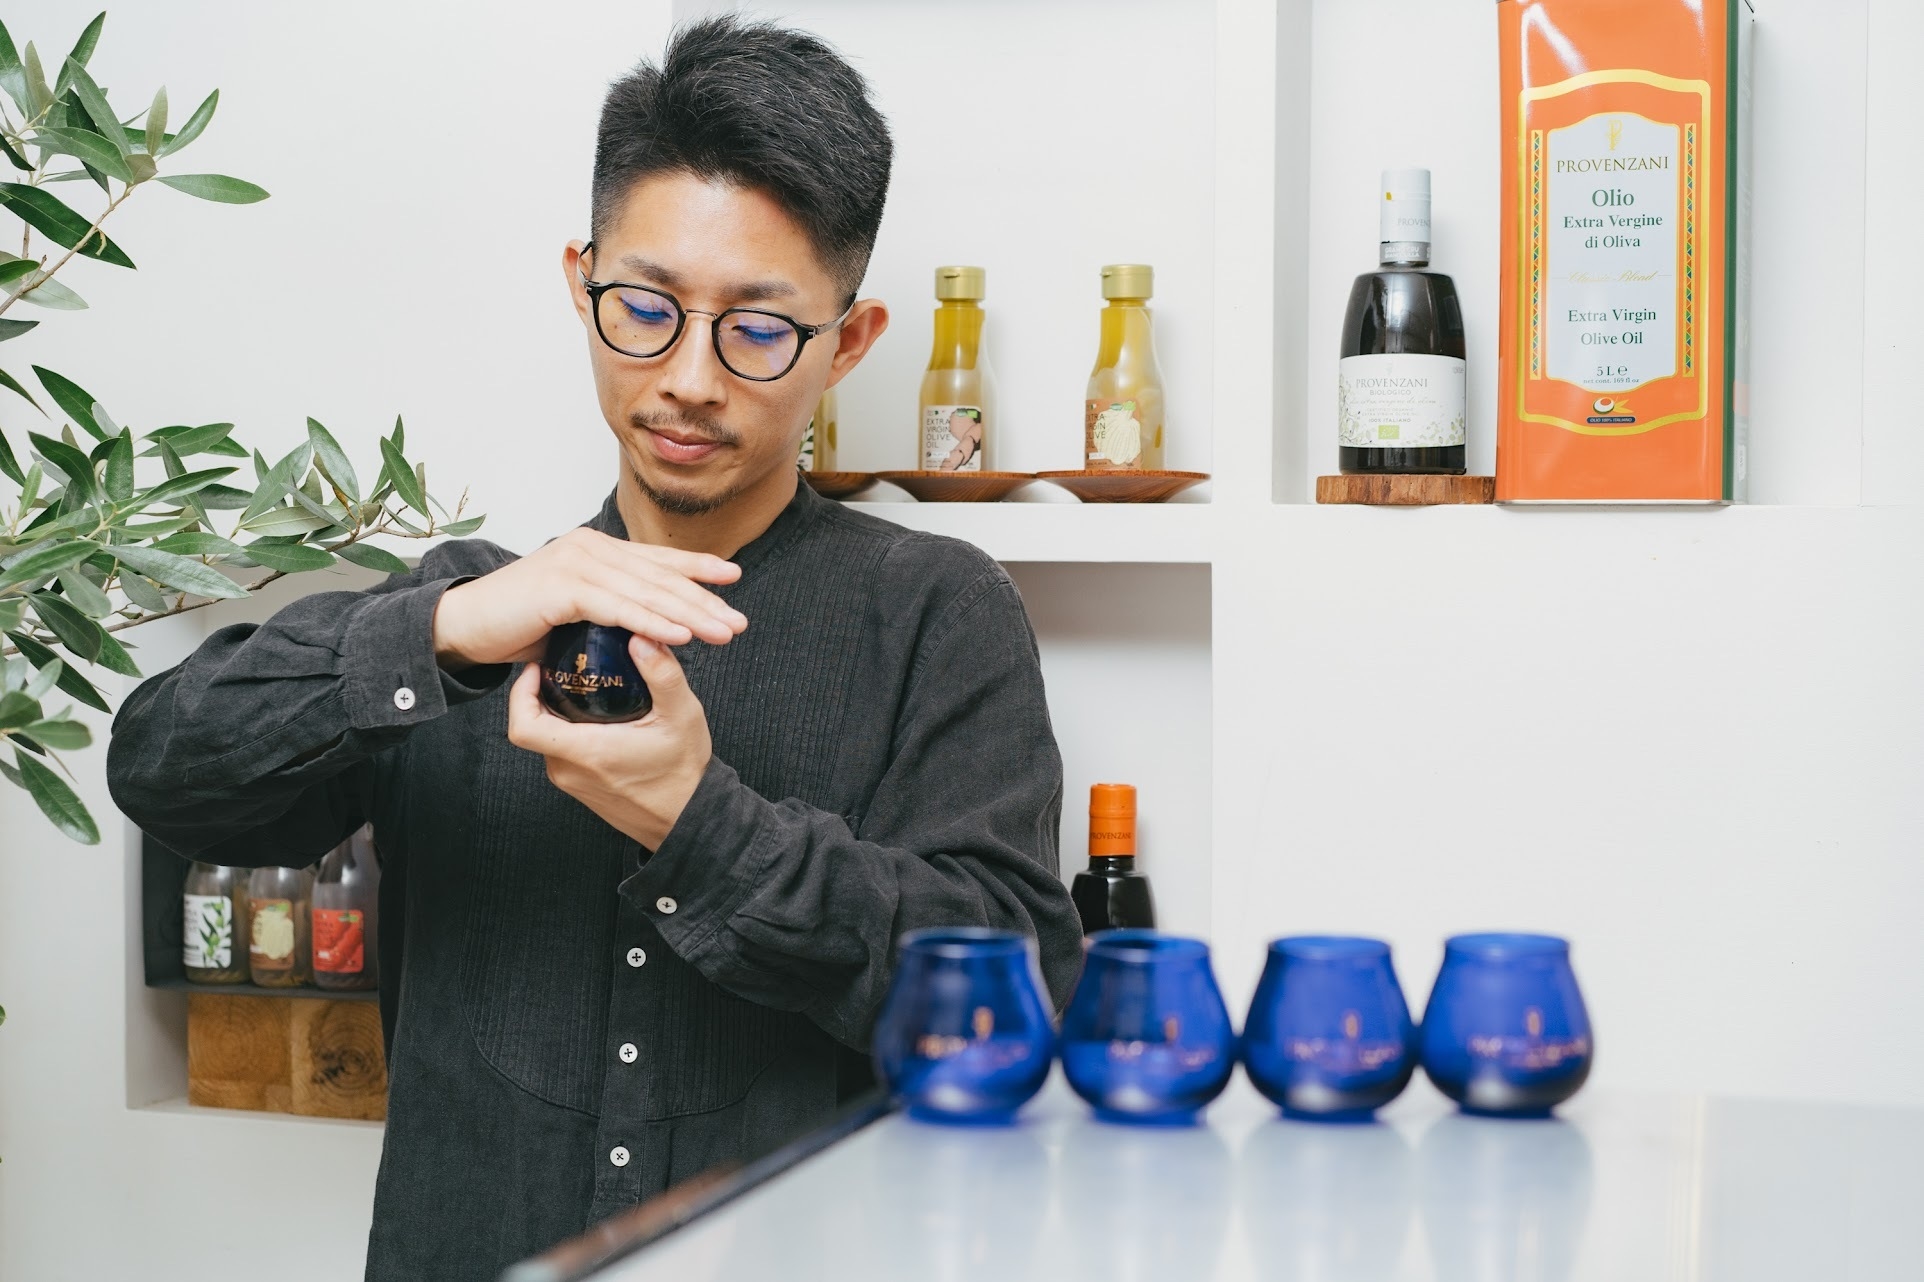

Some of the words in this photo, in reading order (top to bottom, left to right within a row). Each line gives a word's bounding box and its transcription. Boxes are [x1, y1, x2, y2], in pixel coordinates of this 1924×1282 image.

[1556, 156, 1669, 173] PROVENZANI
[1591, 188, 1635, 207] Olio
[1563, 215, 1604, 229] Extra
[1608, 214, 1663, 230] Vergine
[1584, 235, 1598, 249] di
[1603, 235, 1641, 248] Oliva
[1616, 270, 1659, 282] Blend
[1567, 309, 1607, 323] Extra
[1612, 307, 1657, 324] Virgin
[1580, 332, 1618, 346] Olive
[1621, 331, 1643, 345] Oil
[1596, 366, 1604, 377] 5
[1355, 378, 1428, 389] PROVENZANI
[926, 418, 950, 426] EXTRA
[926, 433, 951, 441] OLIVE
[926, 441, 939, 449] OIL
